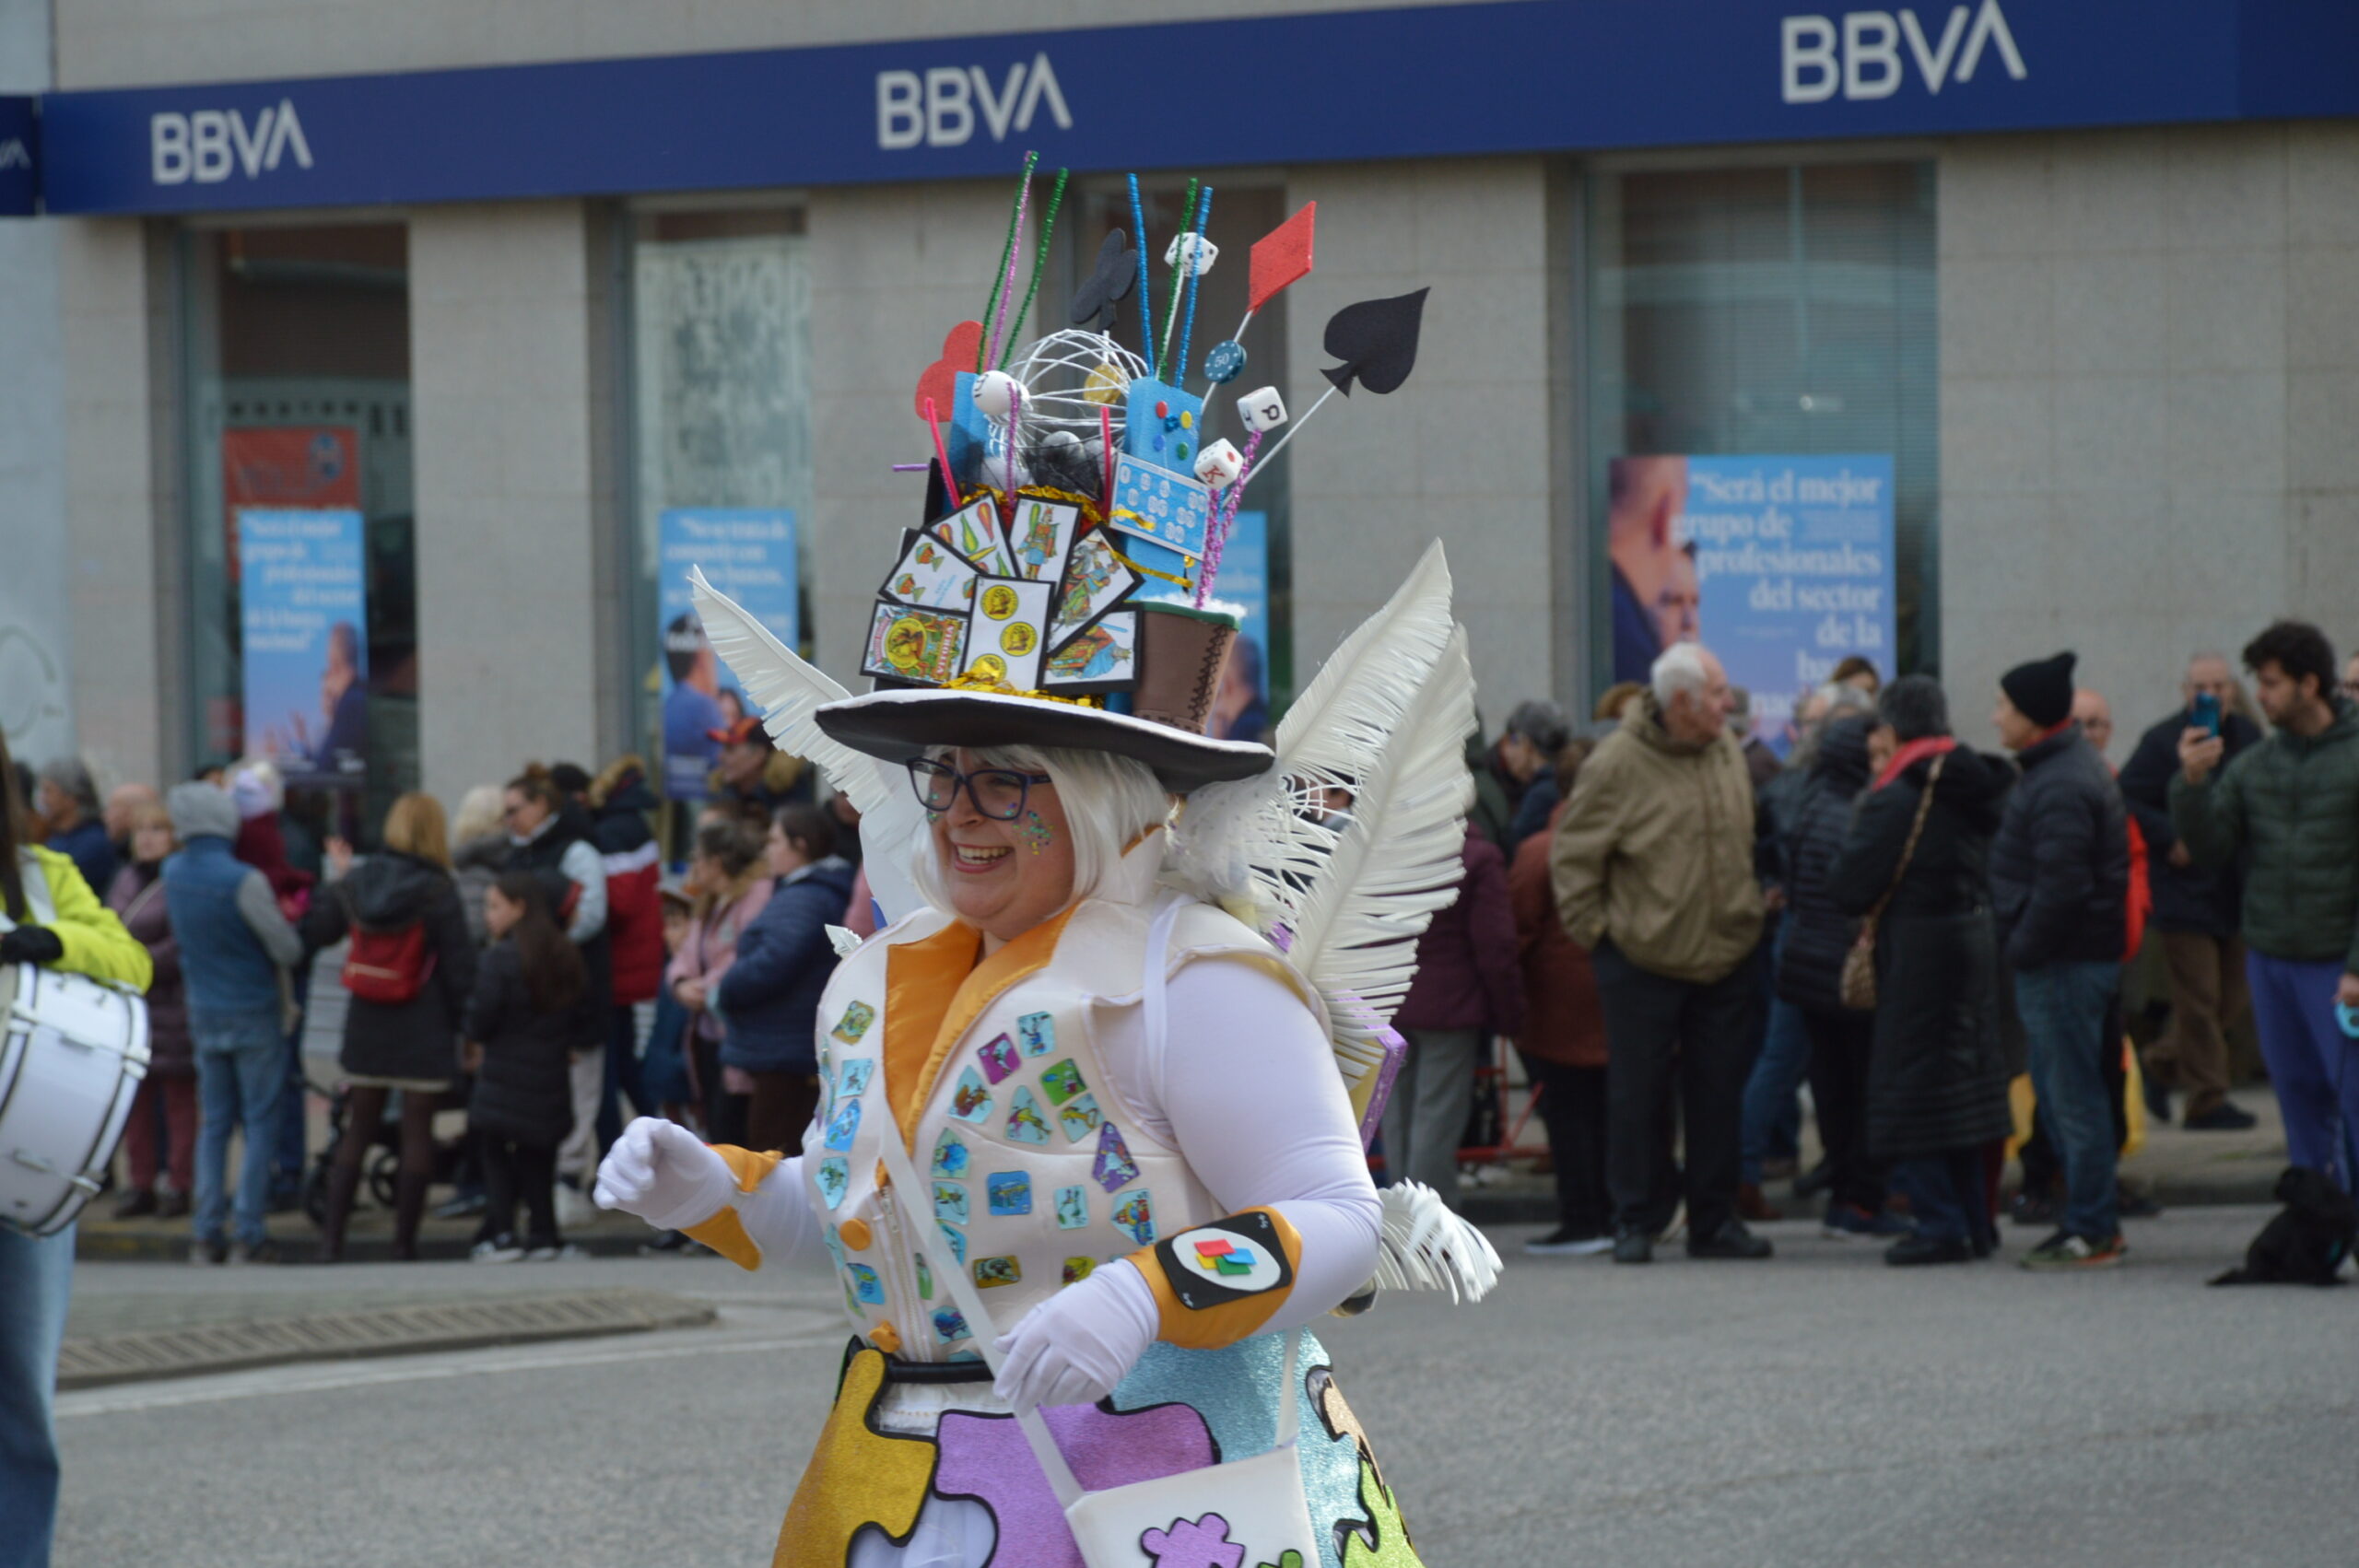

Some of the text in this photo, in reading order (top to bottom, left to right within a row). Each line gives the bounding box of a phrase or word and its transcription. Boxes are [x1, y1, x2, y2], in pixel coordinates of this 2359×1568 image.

[1781, 0, 2027, 104] BBVA
[877, 51, 1074, 149] BBVA
[151, 98, 313, 184] BBVA
[1261, 404, 1280, 421] Q
[1203, 464, 1226, 484] K
[1800, 470, 1883, 509] mejor
[1668, 514, 1754, 546] grupo
[1757, 506, 1793, 539] de
[1696, 542, 1883, 581] profesionales
[1750, 578, 1883, 612] del sector
[936, 625, 955, 675] VITORIA
[1816, 614, 1883, 648] de la
